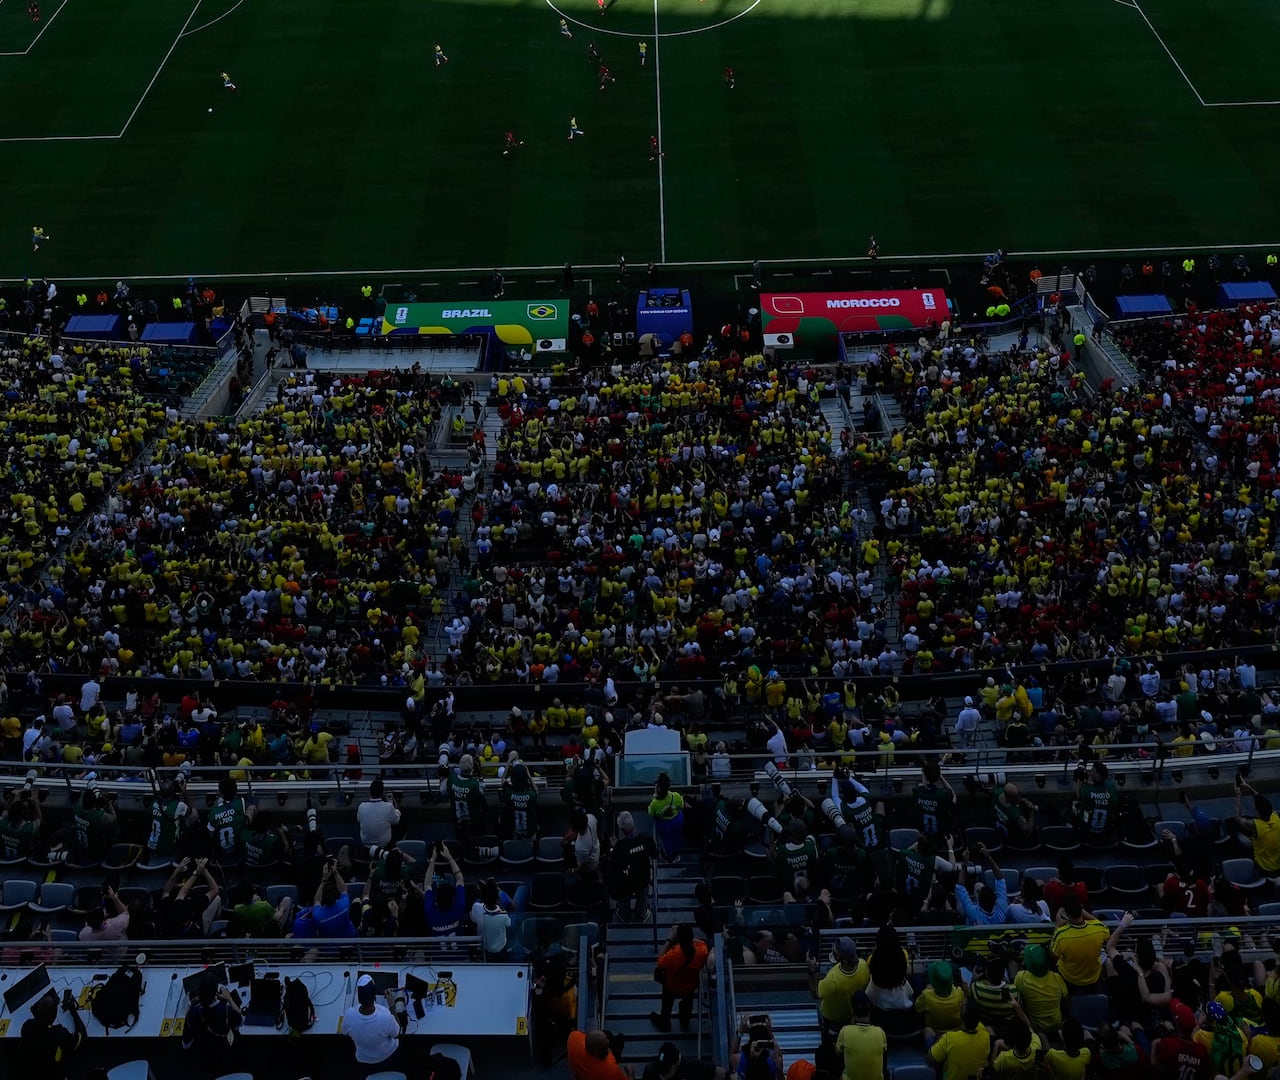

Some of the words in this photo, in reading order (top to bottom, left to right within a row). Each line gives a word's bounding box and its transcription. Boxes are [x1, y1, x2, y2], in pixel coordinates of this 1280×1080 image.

[826, 298, 900, 310] MOROCCO
[441, 309, 492, 319] BRAZIL
[511, 793, 530, 802] PHOTO
[1090, 791, 1111, 800] PHOTO
[215, 808, 235, 820] PHOTO
[854, 808, 873, 821] PHOTO
[629, 845, 644, 855] PRESS
[787, 854, 809, 865] PHOTO
[1184, 889, 1197, 909] 2
[519, 1021, 525, 1030] B
